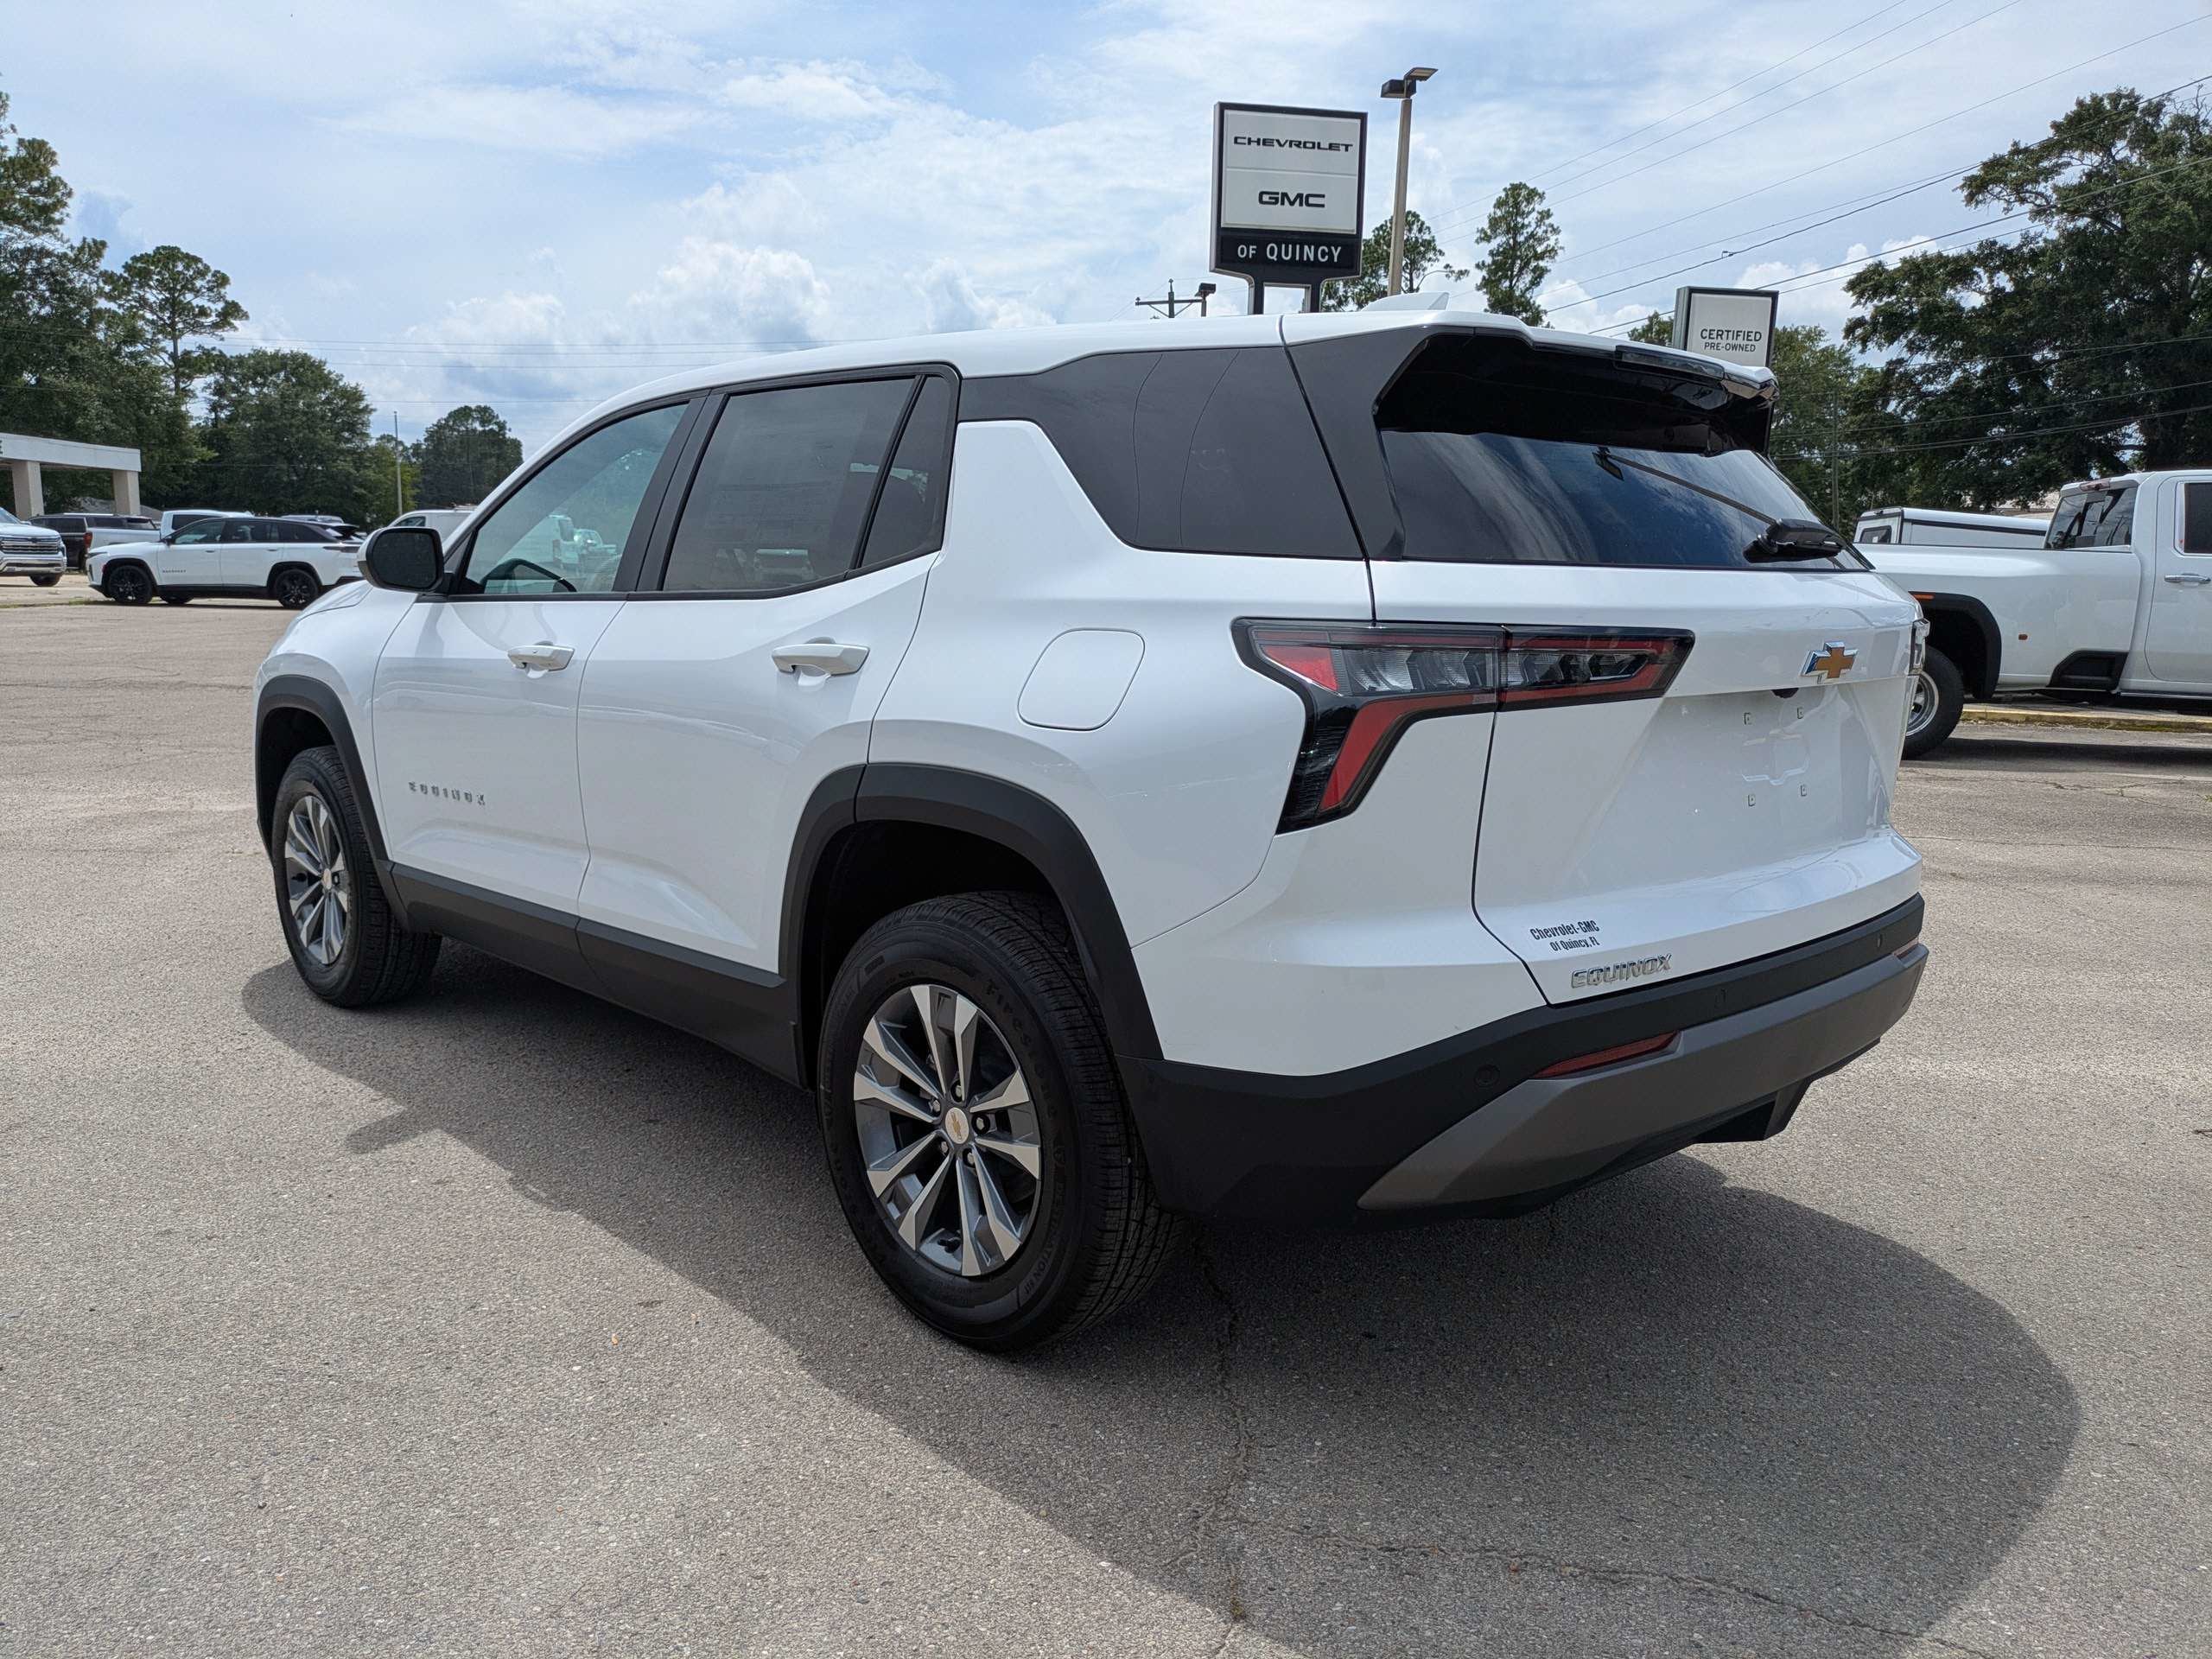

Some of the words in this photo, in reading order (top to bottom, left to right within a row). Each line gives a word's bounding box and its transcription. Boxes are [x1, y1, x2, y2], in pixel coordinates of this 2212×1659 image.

[1233, 136, 1354, 152] CHEVROLET
[1258, 190, 1326, 208] GMC
[1237, 245, 1257, 259] OF
[1266, 243, 1342, 262] QUINCY
[1700, 328, 1762, 341] CERTIFIED
[1704, 342, 1756, 352] PRE-OWNED
[1529, 919, 1600, 941] Chevrolet-GMC
[1571, 953, 1672, 988] EQUINOX
